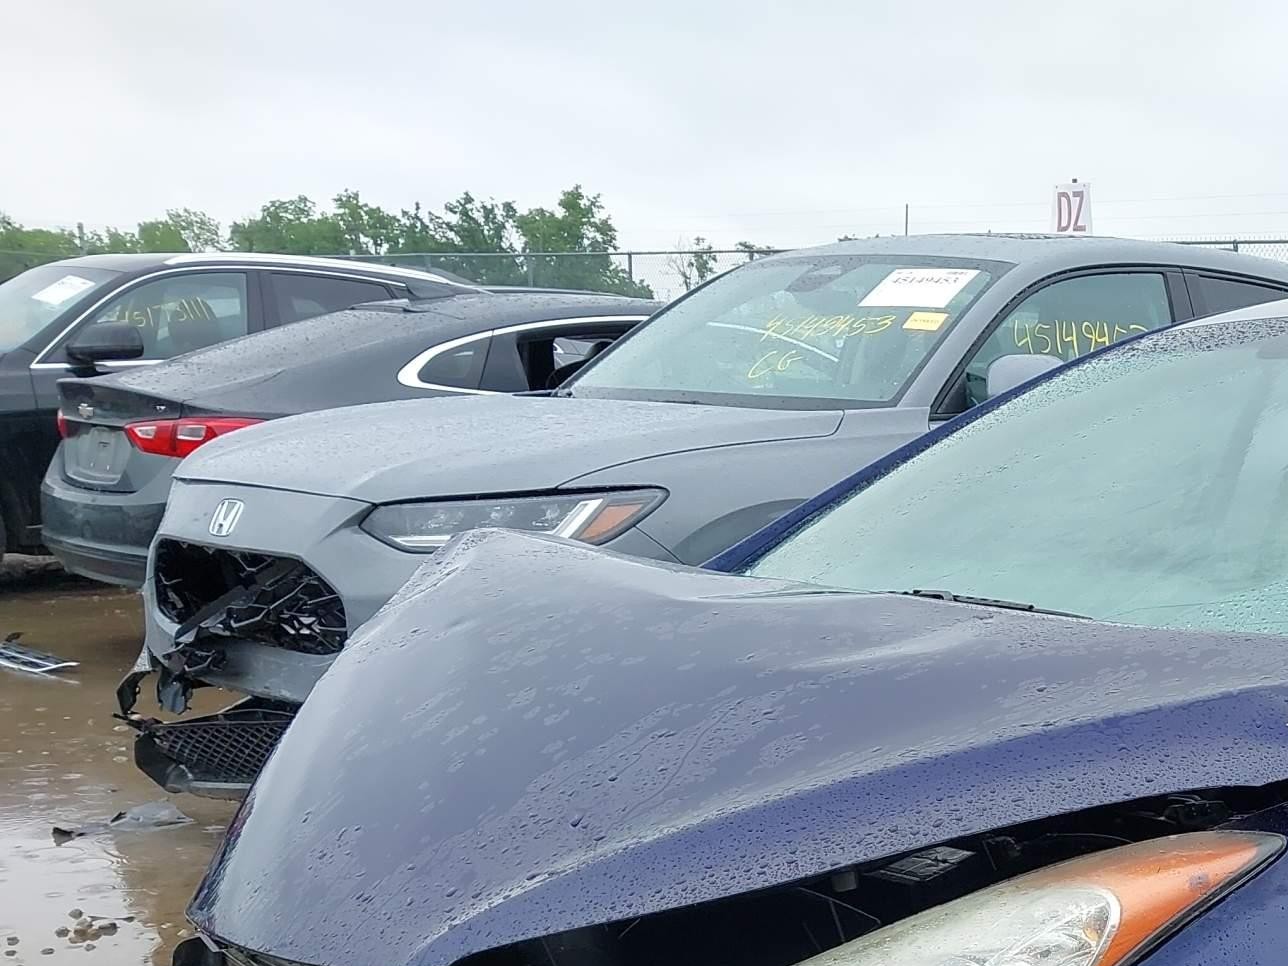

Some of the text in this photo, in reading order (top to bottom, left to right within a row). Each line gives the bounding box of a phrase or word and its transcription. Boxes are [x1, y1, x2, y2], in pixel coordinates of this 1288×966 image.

[1057, 190, 1086, 232] DZ
[760, 313, 896, 342] 45149453
[1014, 320, 1148, 357] 451494
